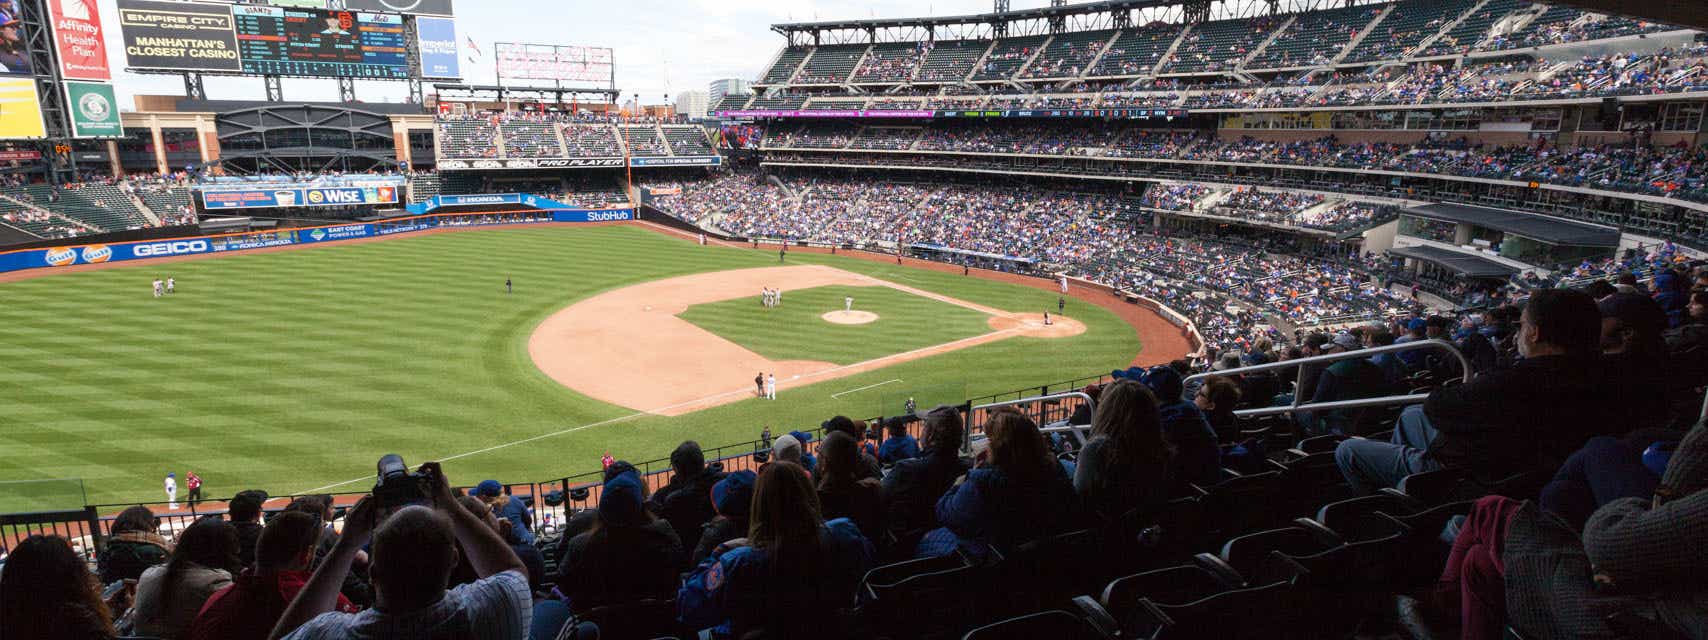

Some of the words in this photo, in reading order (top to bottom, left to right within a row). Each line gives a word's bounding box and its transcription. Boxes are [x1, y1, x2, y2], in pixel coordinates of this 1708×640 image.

[127, 14, 188, 24] EMPIRE
[191, 16, 224, 25] CITY
[60, 20, 98, 36] Affinity
[64, 34, 98, 48] Health
[136, 36, 226, 49] MANHATTAN'S
[72, 46, 95, 57] Plan
[127, 47, 186, 57] CLOSEST
[189, 49, 236, 59] CASINO
[323, 190, 362, 202] WISE
[588, 211, 628, 220] StubHub
[134, 240, 207, 256] GEICO
[48, 250, 74, 262] Gulf
[84, 248, 109, 260] Gulf
